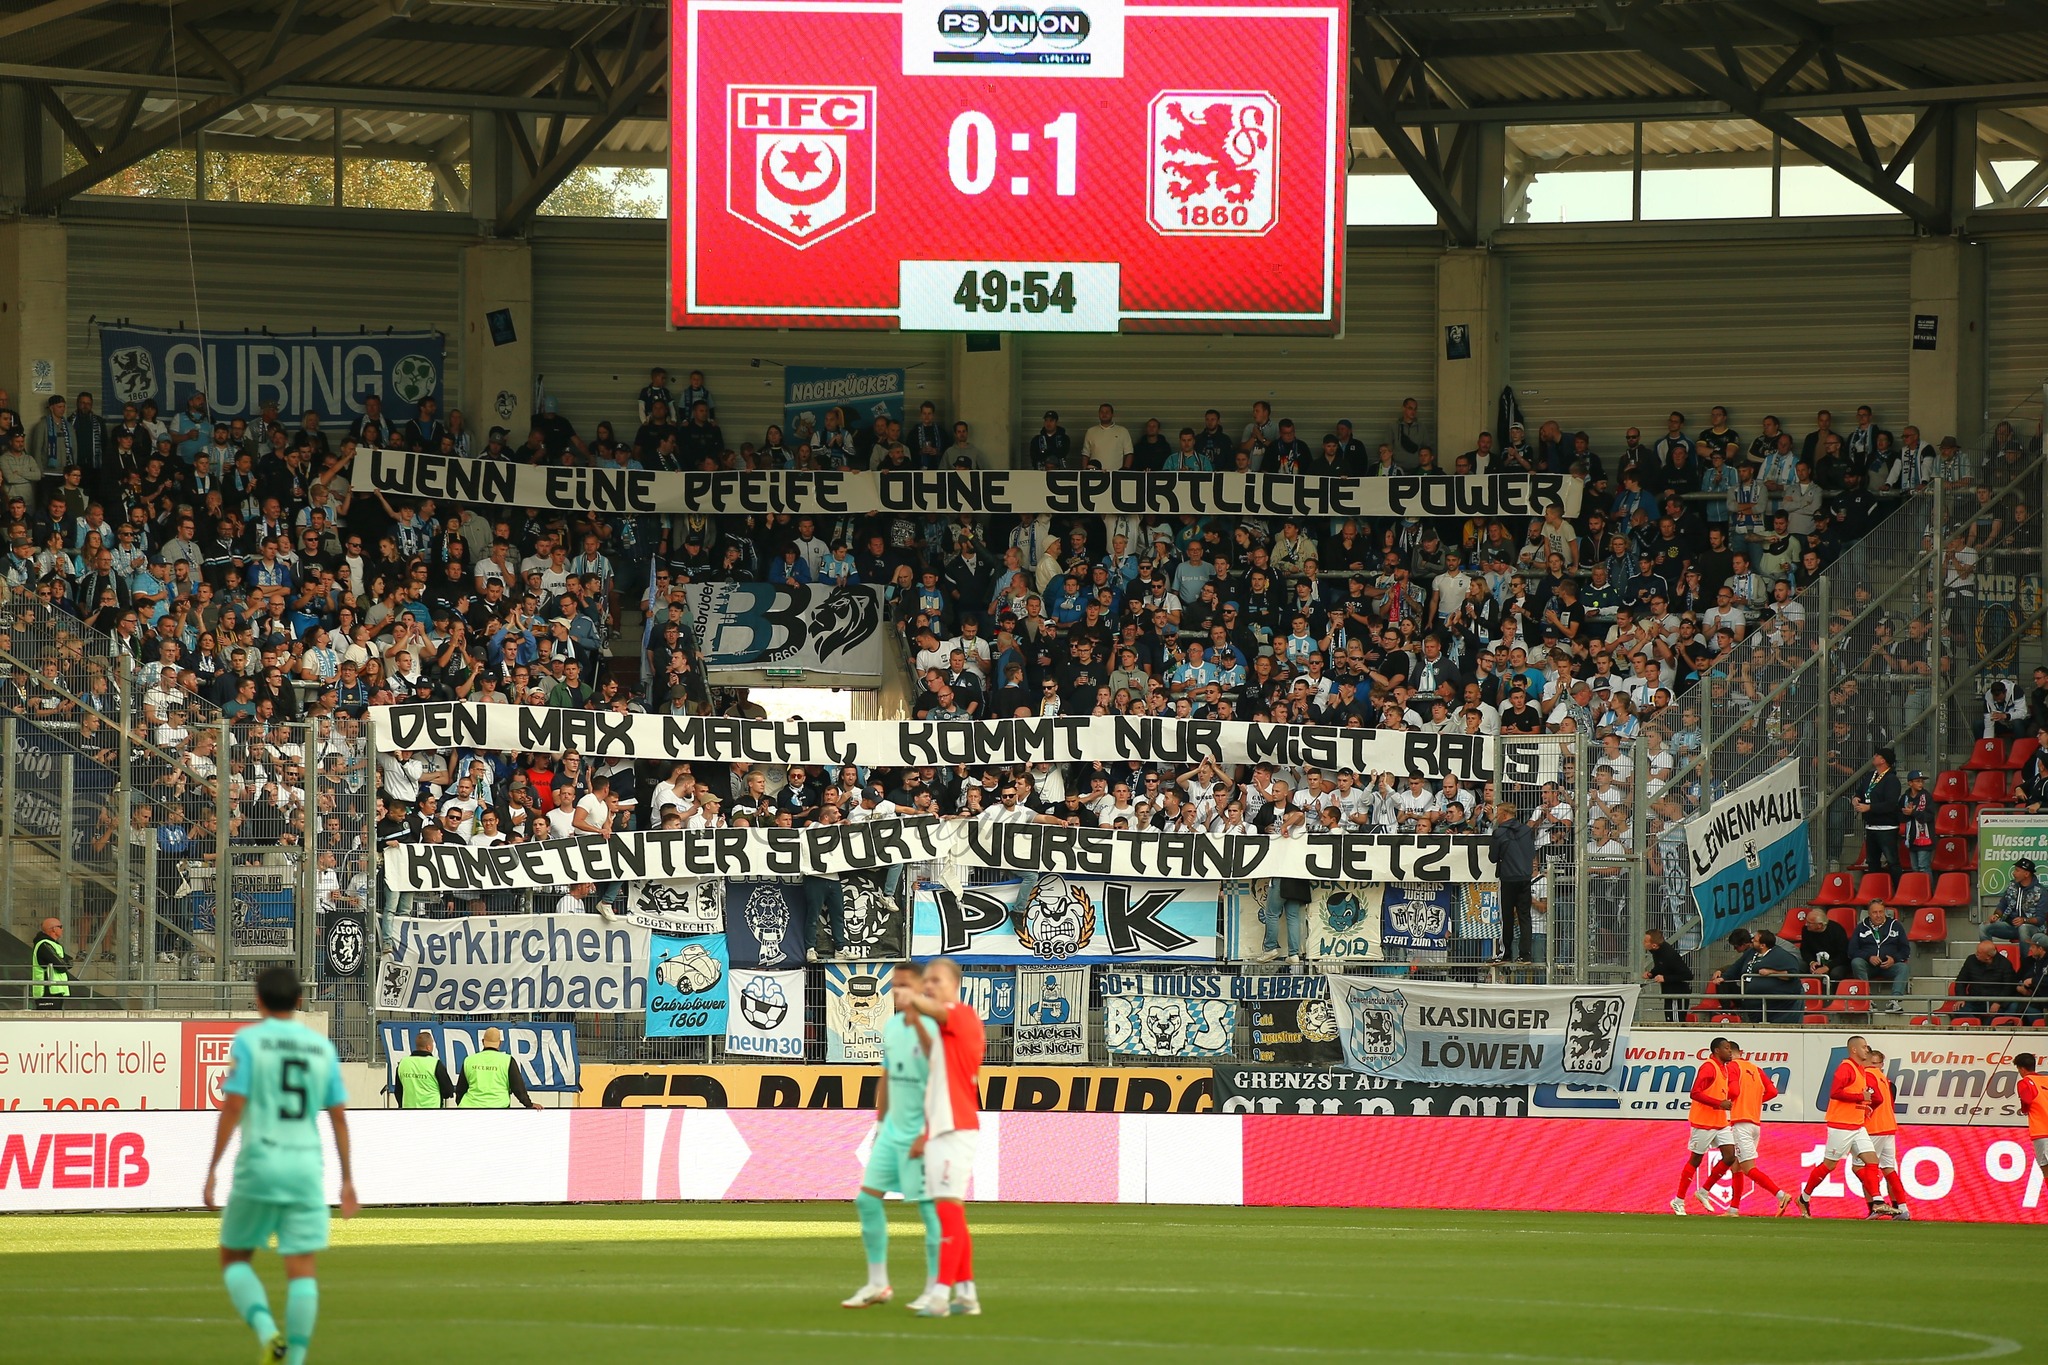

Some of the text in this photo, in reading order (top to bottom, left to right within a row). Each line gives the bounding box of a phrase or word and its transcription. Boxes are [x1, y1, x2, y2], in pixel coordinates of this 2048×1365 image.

[943, 14, 1080, 33] PS UNION
[744, 97, 860, 128] HFC
[947, 110, 1078, 196] 0:1
[1175, 204, 1250, 227] 1860
[953, 270, 1078, 314] 49:54
[165, 343, 384, 416] AUBING
[128, 390, 149, 402] 1860
[370, 450, 517, 504] WENN
[879, 471, 1010, 512] OHNE
[1388, 473, 1565, 516] POWER
[768, 645, 801, 664] 1860
[389, 702, 488, 750] DEN
[518, 708, 635, 757] MAX
[662, 715, 858, 766] MACHT,
[899, 716, 1091, 766] KOMMT
[1113, 715, 1224, 764] NUR
[1403, 731, 1540, 785] RAUS
[1692, 787, 1802, 876] LÖWENMAUL
[1992, 834, 2048, 847] Wasser &
[407, 827, 752, 890] KOMPETENTER
[765, 817, 941, 875] SPORT
[967, 820, 1270, 878] VORSTAND
[1403, 891, 1437, 901] JUGEND
[336, 925, 359, 935] LEON
[636, 916, 715, 933] GEGEN RECHTS
[1033, 941, 1078, 955] 1860
[1319, 936, 1369, 957] WOID
[1383, 935, 1410, 946] STEHT
[1411, 937, 1431, 948] ZUM
[407, 965, 648, 1011] Pasenbach
[1153, 975, 1221, 998] MUSS
[1230, 975, 1327, 1000] BLEIBEN!
[650, 994, 727, 1013] Cabriolöwen
[669, 1012, 708, 1028] 1860
[1419, 1005, 1551, 1030] KASINGER
[1016, 1025, 1083, 1042] KNACKEN
[1253, 1030, 1303, 1046] Augustiner
[202, 1042, 230, 1061] HF
[728, 1033, 803, 1056] neun30
[1015, 1041, 1043, 1056] UNS
[1420, 1035, 1545, 1070] LÖWEN
[19, 1041, 108, 1074] wirklich
[117, 1041, 167, 1074] tolle
[1570, 1060, 1602, 1071] 1860
[403, 1072, 429, 1080] SECURITY
[471, 1064, 499, 1072] SECURITY
[278, 1057, 311, 1121] 5
[1630, 1098, 1692, 1111] an de
[1917, 1105, 1947, 1116] an
[1953, 1103, 1994, 1116] der
